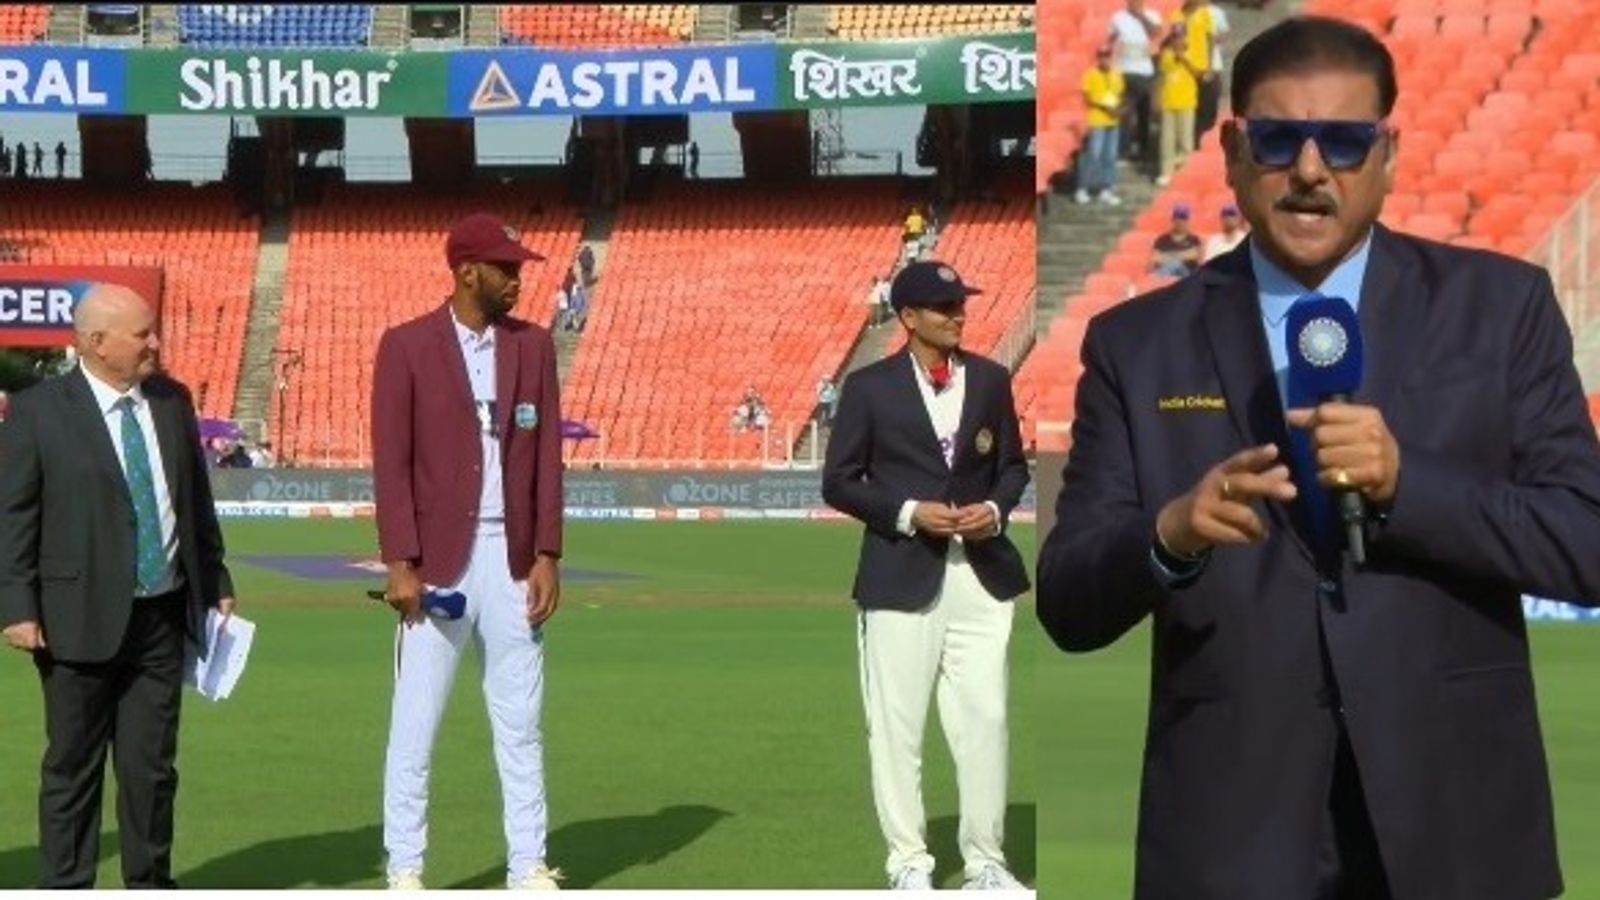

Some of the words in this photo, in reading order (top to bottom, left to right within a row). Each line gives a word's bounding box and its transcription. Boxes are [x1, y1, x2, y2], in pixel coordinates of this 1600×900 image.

[0, 59, 107, 105] RAL
[179, 56, 392, 110] Shikhar
[528, 56, 755, 108] ASTRAL
[789, 49, 922, 101] शिखर
[0, 288, 73, 323] CER
